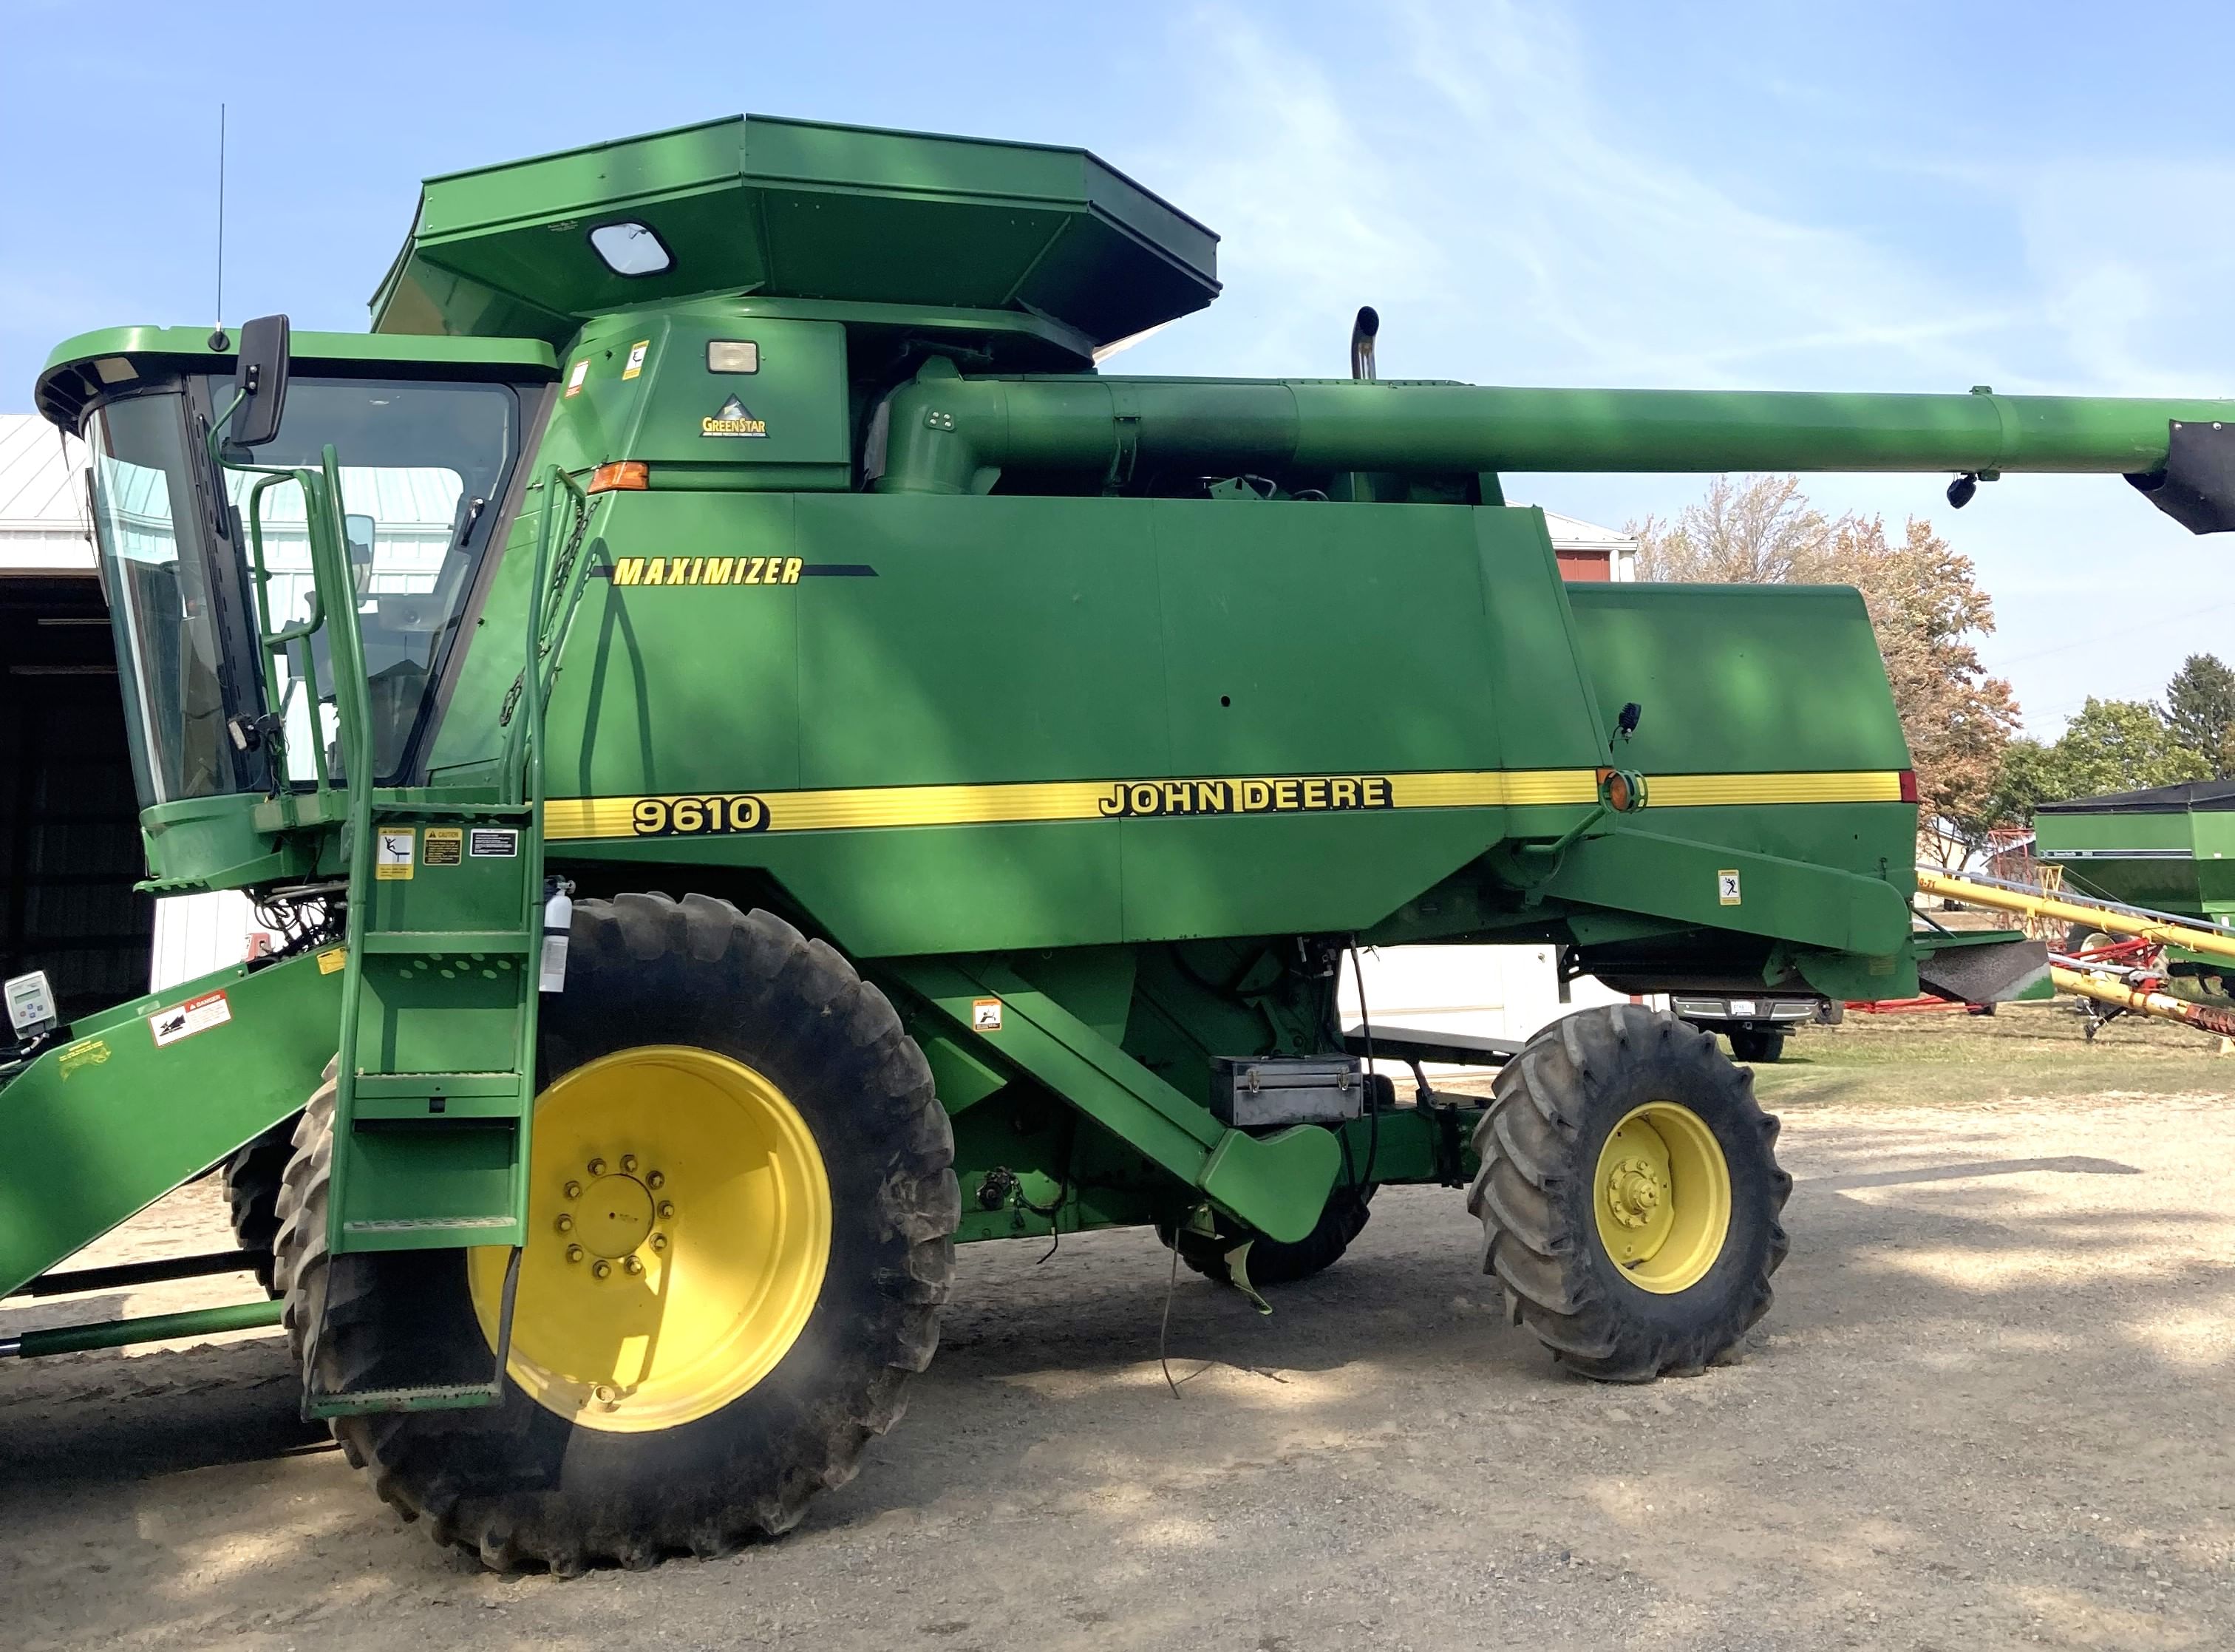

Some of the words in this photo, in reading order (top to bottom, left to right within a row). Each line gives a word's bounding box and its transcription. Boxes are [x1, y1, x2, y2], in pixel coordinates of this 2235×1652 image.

[612, 557, 804, 585] MAXIMIZER
[1098, 781, 1233, 817] JOHN
[1241, 777, 1391, 812] DEERE
[633, 796, 769, 835] 9610
[196, 994, 221, 1007] DANGER
